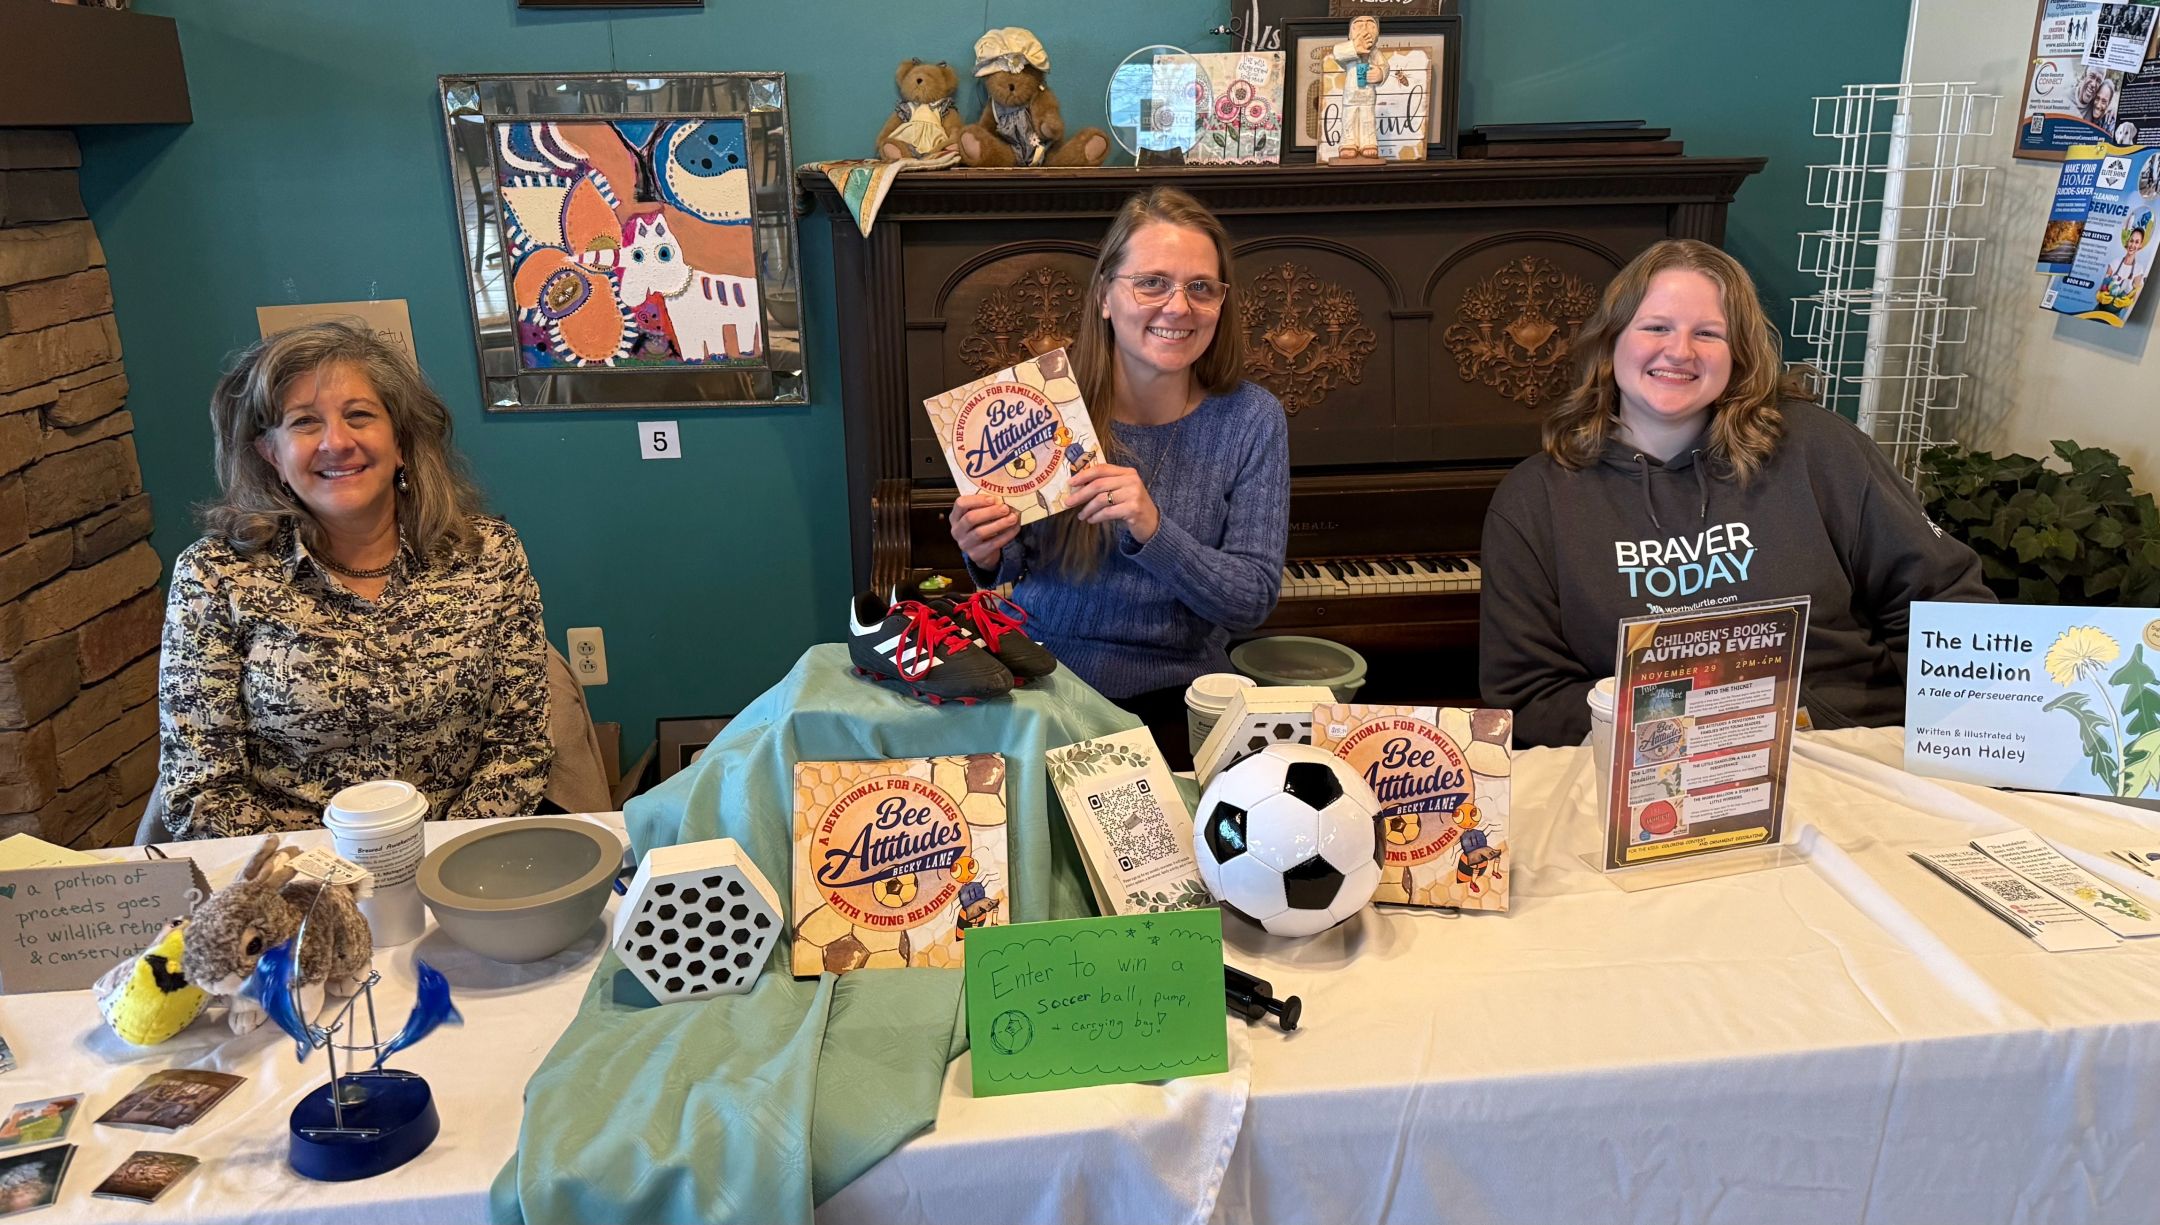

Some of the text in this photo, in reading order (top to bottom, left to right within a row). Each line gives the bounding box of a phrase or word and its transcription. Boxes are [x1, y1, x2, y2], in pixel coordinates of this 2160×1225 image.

[2062, 174, 2094, 186] HOME
[2065, 164, 2098, 174] MAKE YOUR
[2056, 187, 2094, 196] SUICIDE-SAFER
[2088, 201, 2130, 216] SERVICE
[2092, 232, 2110, 240] SERVICE
[956, 394, 986, 442] DEVOTIONAL
[986, 385, 1003, 397] FOR
[1005, 385, 1045, 406] FAMILIES
[986, 399, 1027, 427] Bee
[652, 431, 669, 453] 5
[966, 404, 1053, 473] Attitudes
[1014, 426, 1053, 458] BECKY LANE
[980, 449, 1062, 494] WITH YOUNG READERS
[1615, 522, 1753, 567] BRAVER
[1618, 548, 1758, 598] TODAY
[1641, 632, 1786, 664] AUTHOR EVENT
[1654, 622, 1778, 648] CHILDREN'S BOOKS
[1920, 631, 2033, 653] The Little
[1641, 667, 1699, 682] NOVEMBER
[1704, 664, 1717, 674] 29
[1920, 659, 2030, 682] Dandelion
[1720, 686, 1730, 694] THE
[1730, 683, 1752, 692] THICKET
[1918, 687, 2044, 703] A Tale of Perseverance
[1657, 722, 1674, 732] Bee
[1916, 727, 2026, 742] Written & Illustrated by
[1335, 720, 1461, 767] EVOTIONAL FOR FAMILIES
[1382, 738, 1434, 769] Bee
[1916, 740, 2026, 764] Megan Haley
[819, 779, 958, 846] A DEVOTIONAL FOR FAMILIES
[876, 796, 931, 830] Bee
[1396, 796, 1457, 814] BECKY LANE
[358, 845, 383, 854] Brewed
[825, 820, 962, 880] Attitudes
[1384, 826, 1458, 862] UNG READERS
[892, 850, 955, 877] BECKY LANE
[28, 868, 148, 900] a portion of
[16, 895, 160, 928] proceeds goes
[829, 882, 956, 926] WITH YOUNG READERS
[14, 917, 168, 948] to wildlife reha
[30, 951, 42, 964] &
[992, 950, 1184, 999] Enter to win a
[1037, 986, 1191, 1014] soccer ball, pump,
[1072, 1018, 1124, 1041] carrying
[1134, 1012, 1166, 1038] bag!
